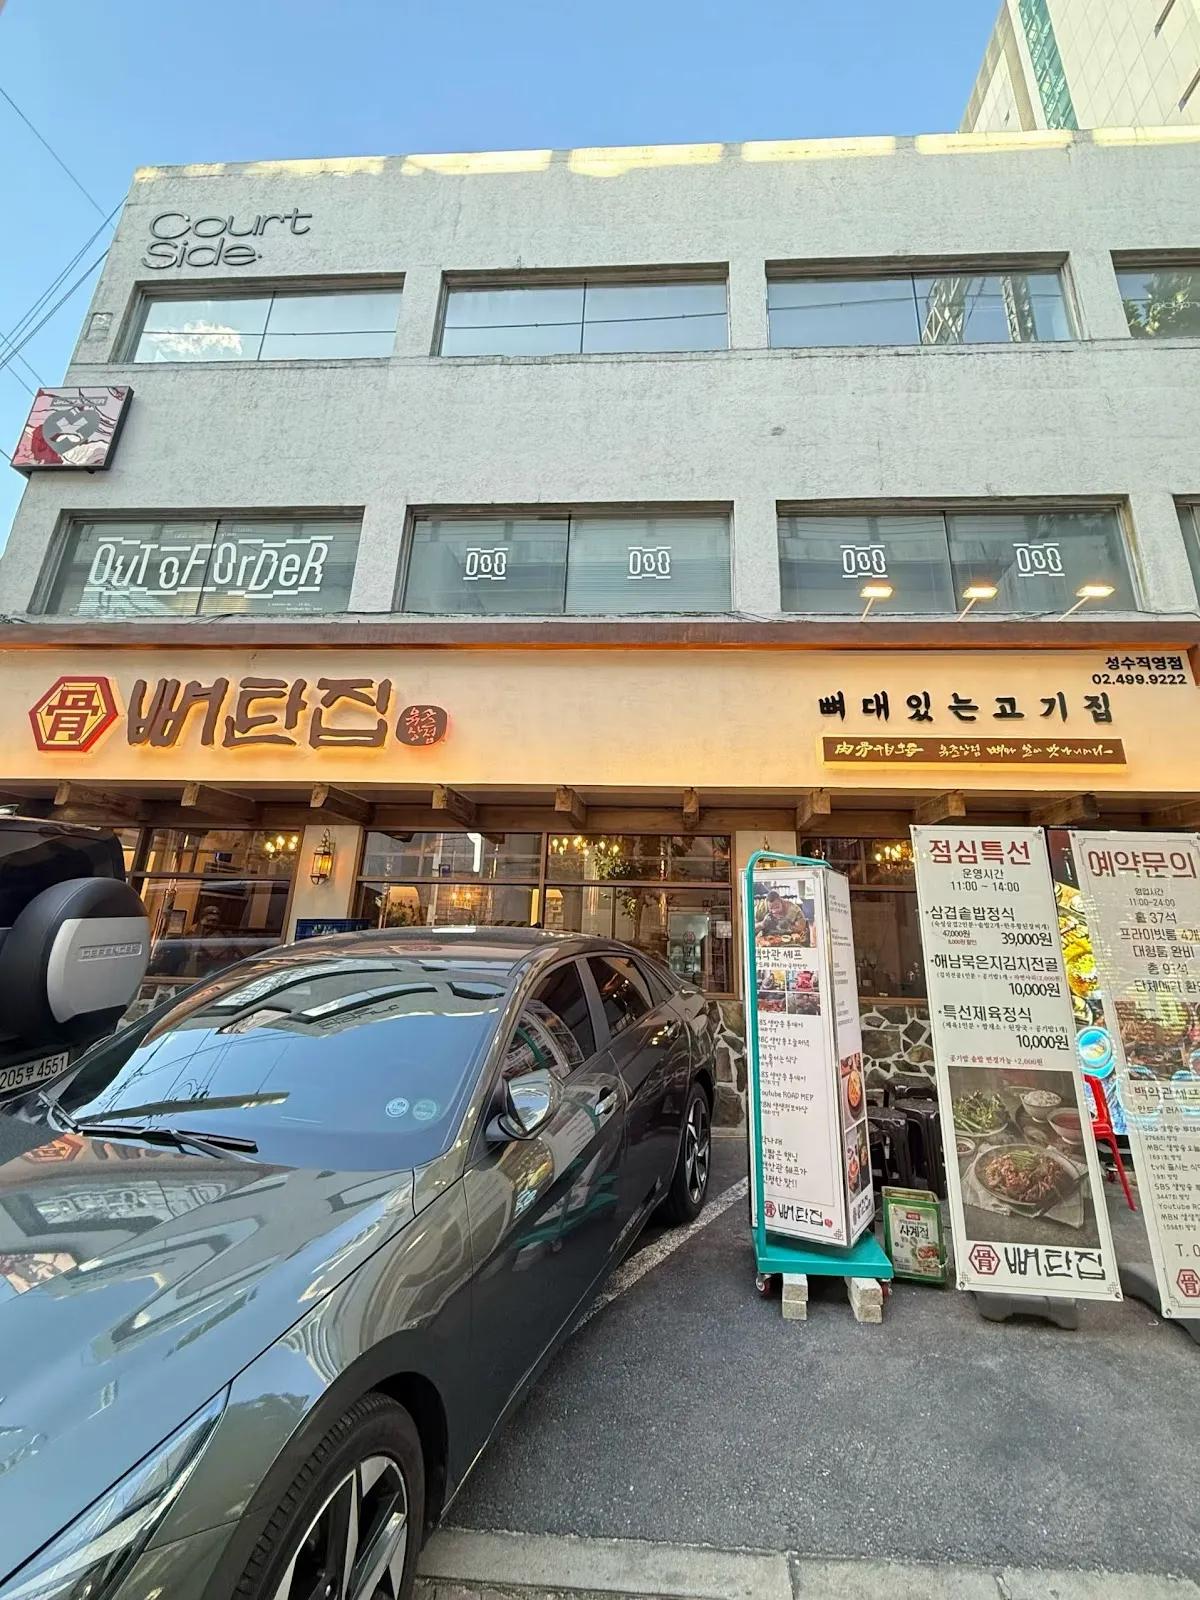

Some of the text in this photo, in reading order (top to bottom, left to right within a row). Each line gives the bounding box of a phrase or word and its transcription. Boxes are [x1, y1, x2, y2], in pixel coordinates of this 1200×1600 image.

[150, 208, 312, 239] Court
[1105, 656, 1183, 670] 성수직영점
[1092, 674, 1187, 685] 02.499.9222
[46, 689, 101, 742] 骨
[127, 677, 394, 750] 뼈탄집
[929, 840, 1031, 865] 점심특선
[1088, 851, 1197, 878] 예약문의
[962, 868, 1004, 880] 운영시간
[950, 882, 978, 891] 11:00
[993, 882, 1020, 892] 14:00
[930, 905, 1015, 922] 삼겹솥밥정식
[1001, 932, 1052, 947] 39,000원
[1119, 927, 1177, 941] 프라이빗룸
[1171, 945, 1195, 958] 완비
[935, 954, 1059, 972] 해남묵은지김치전골
[1009, 982, 1061, 998] 10,000원
[943, 1005, 1032, 1023] 특선제육정식
[1016, 1035, 1070, 1050] 10,000원
[0, 1056, 66, 1090] 205부 4551
[975, 1247, 1106, 1280] 骨 뼈탄집
